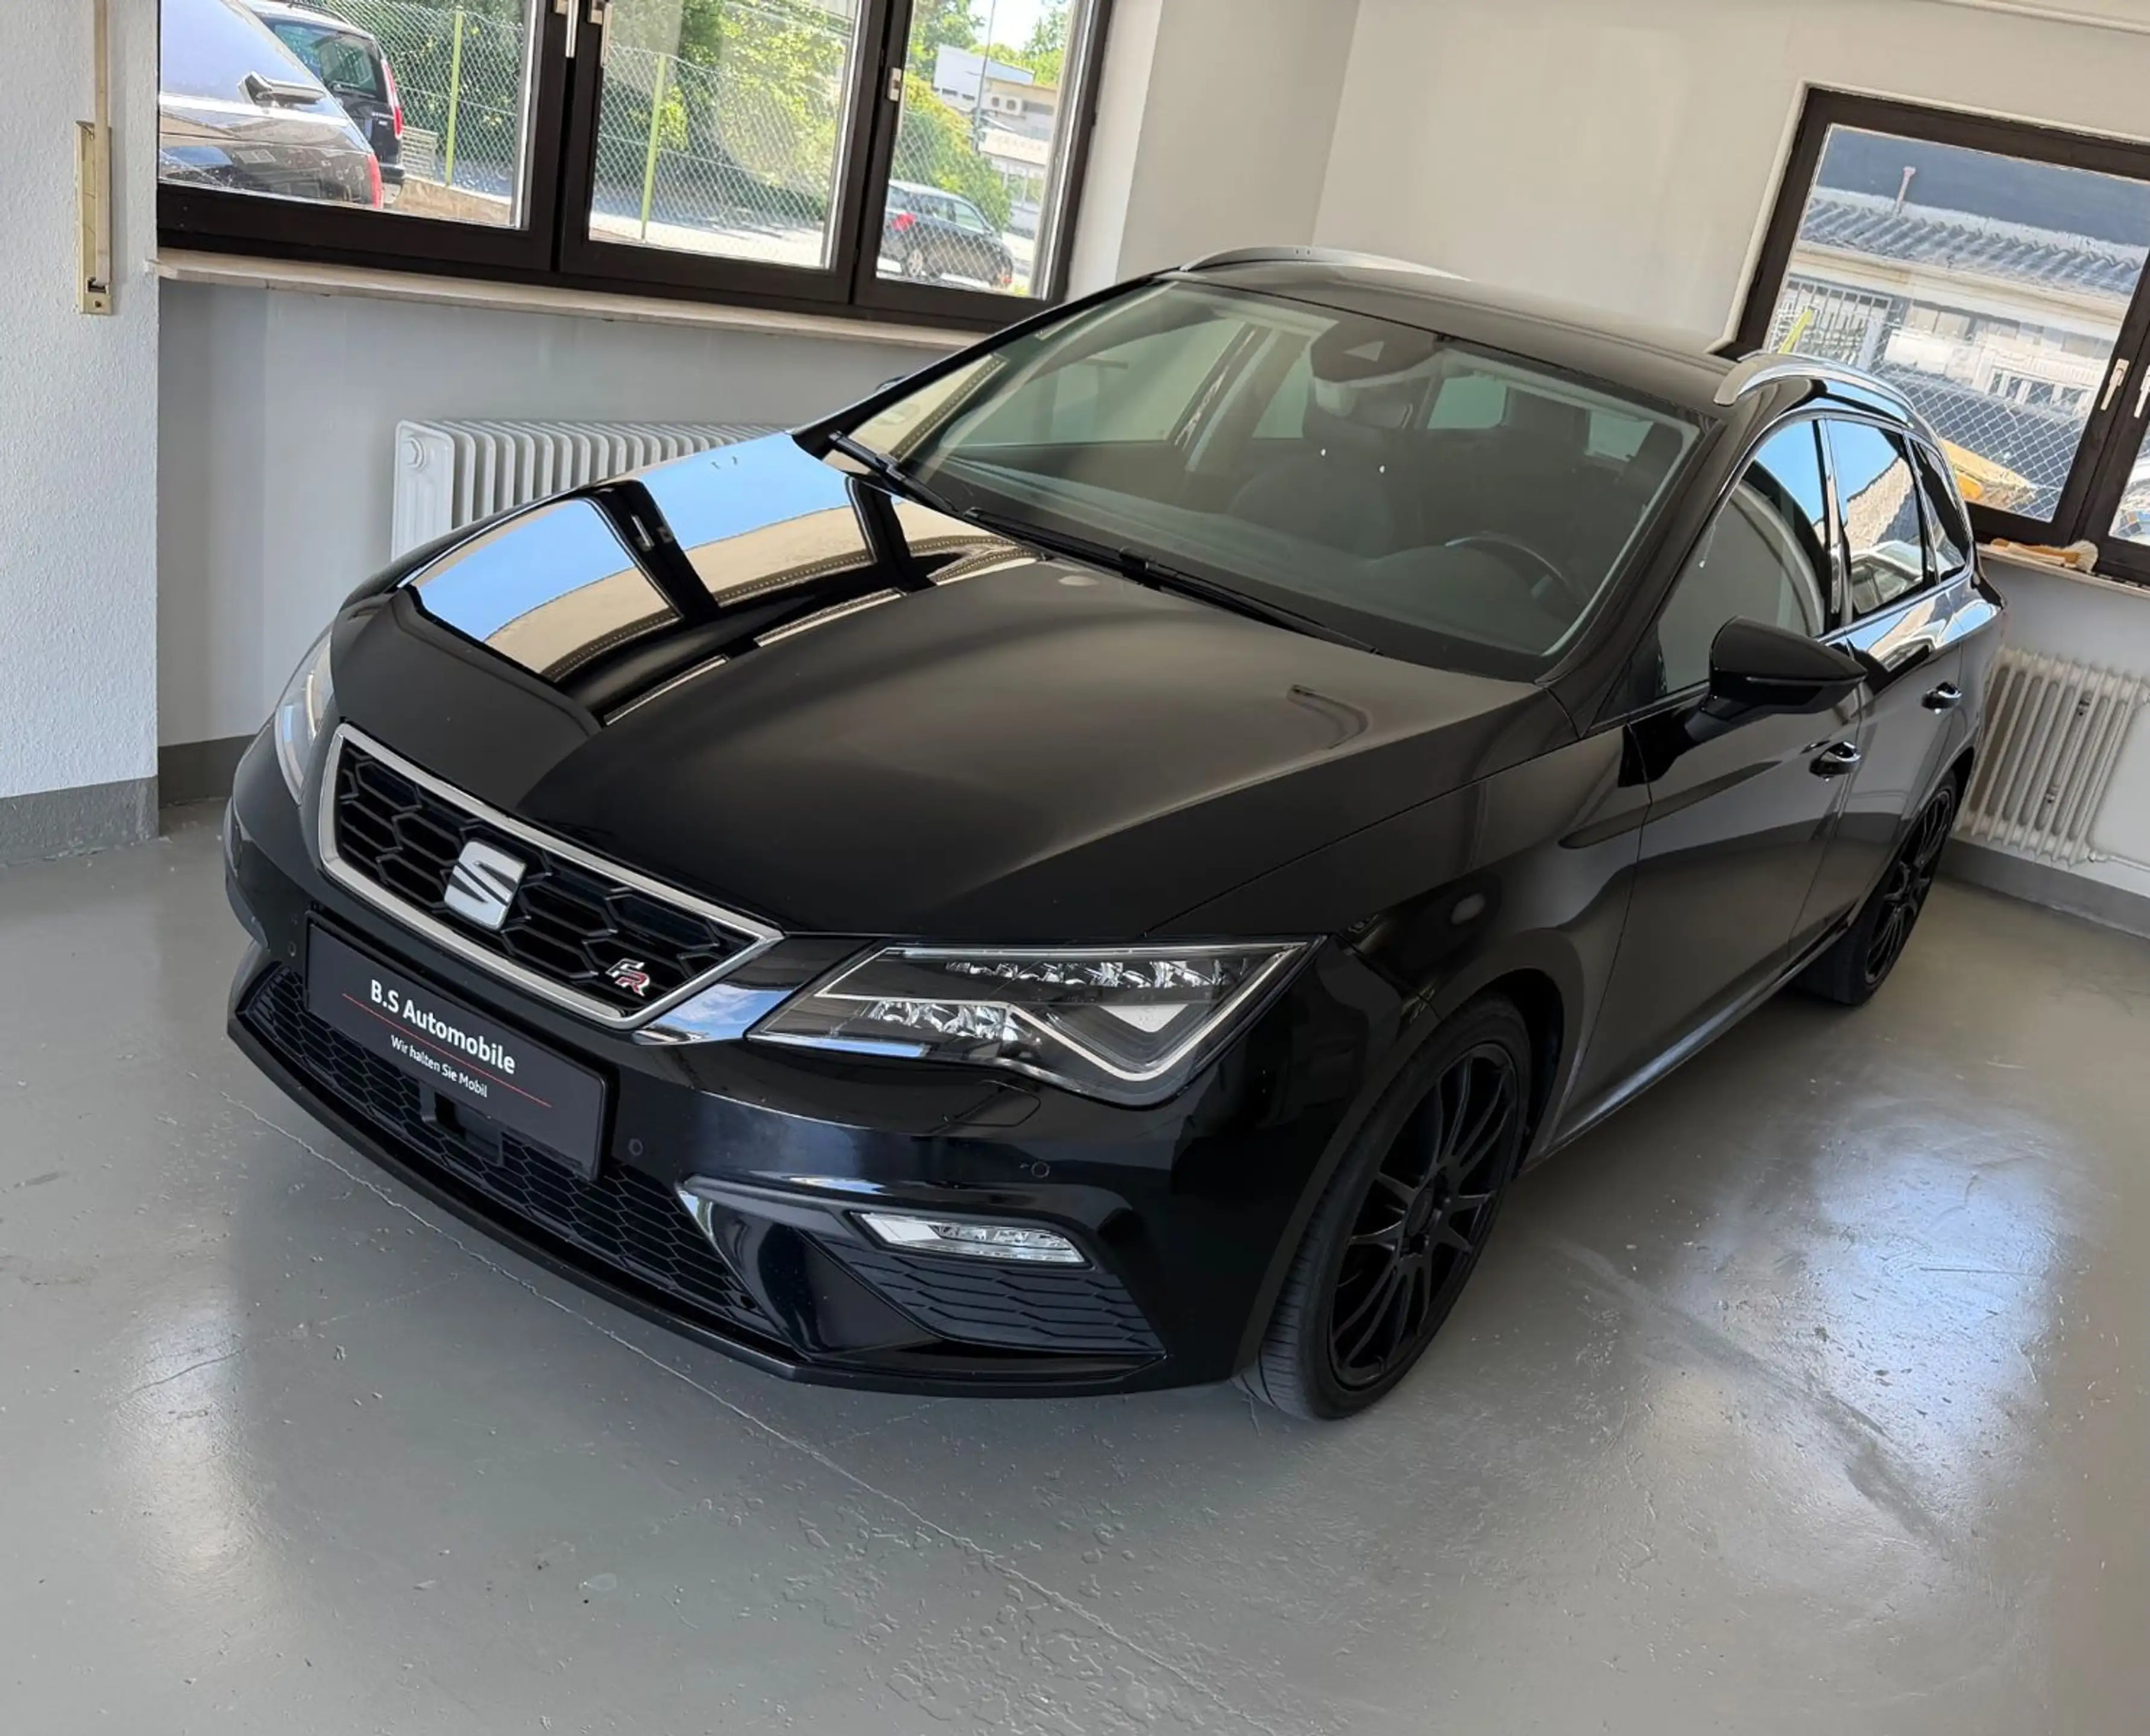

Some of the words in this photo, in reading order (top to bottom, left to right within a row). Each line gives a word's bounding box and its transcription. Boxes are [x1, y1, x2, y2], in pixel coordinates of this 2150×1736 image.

[371, 979, 399, 1013] B.S
[403, 999, 515, 1075] Automobile
[391, 1034, 408, 1054] Wir
[409, 1045, 441, 1072] halten
[441, 1063, 458, 1081] Sie
[459, 1072, 488, 1098] Mobil
